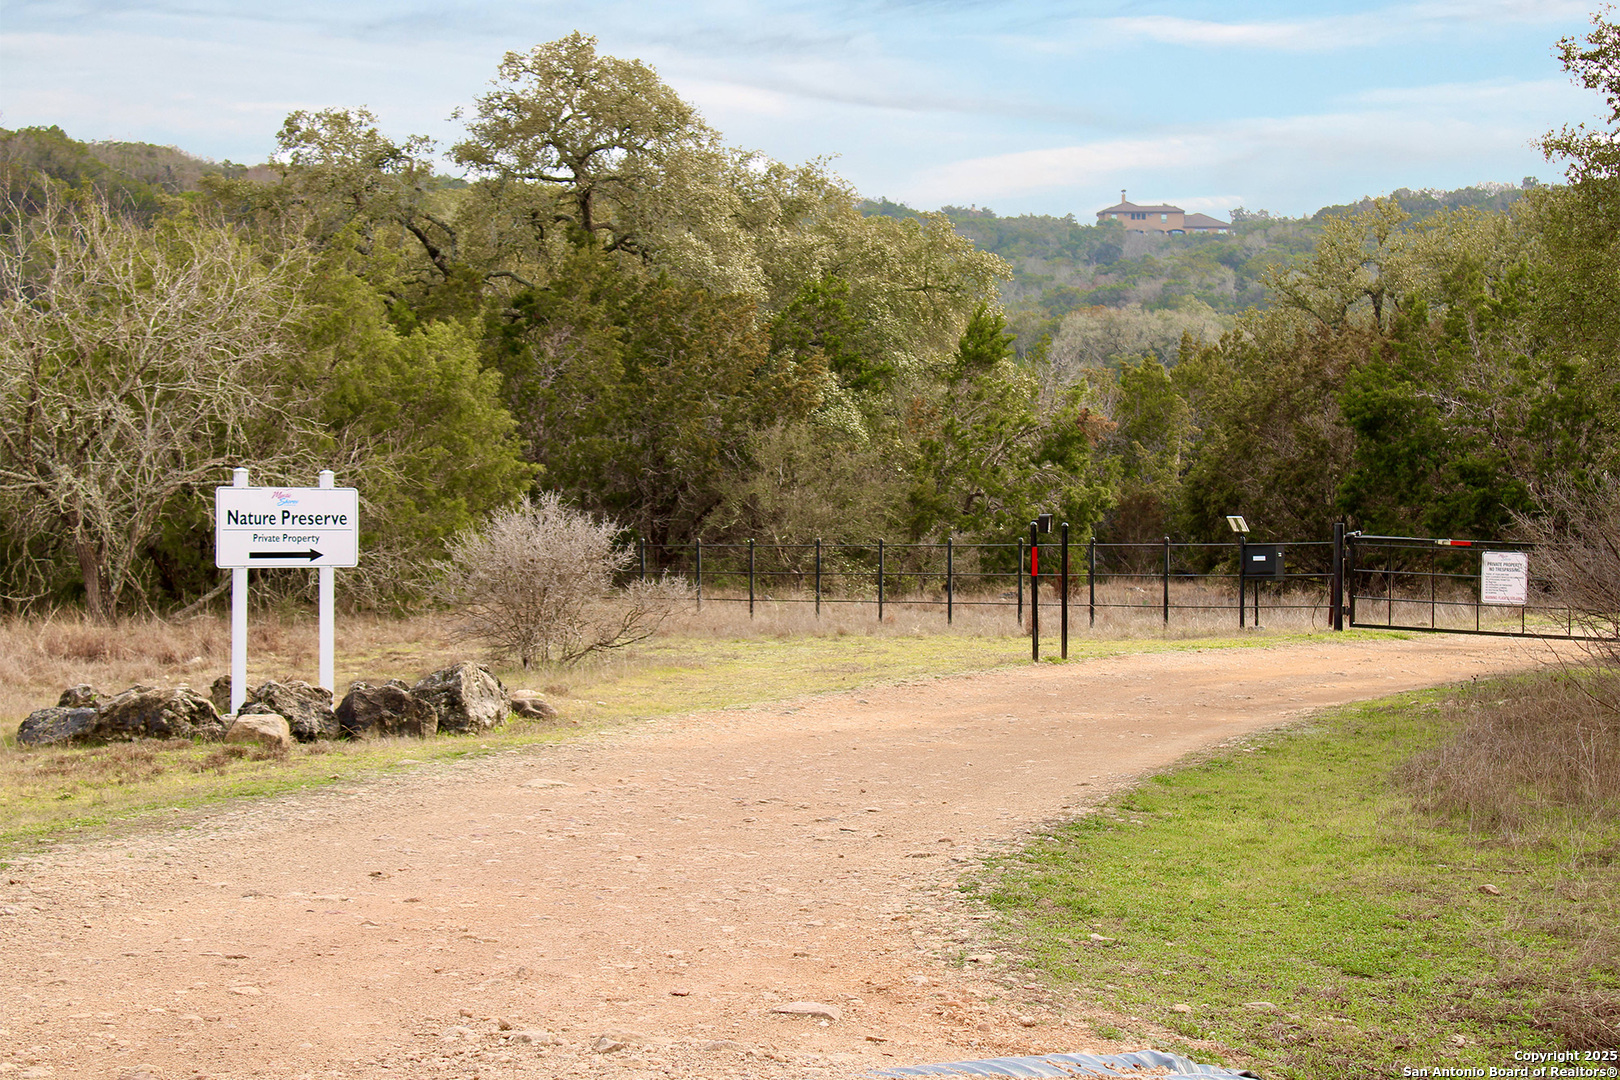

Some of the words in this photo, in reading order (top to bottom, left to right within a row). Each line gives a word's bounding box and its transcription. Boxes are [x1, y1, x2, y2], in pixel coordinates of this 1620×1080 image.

[227, 509, 277, 526] Nature
[281, 509, 348, 526] Preserve
[252, 533, 280, 543] Private
[282, 533, 320, 545] Property
